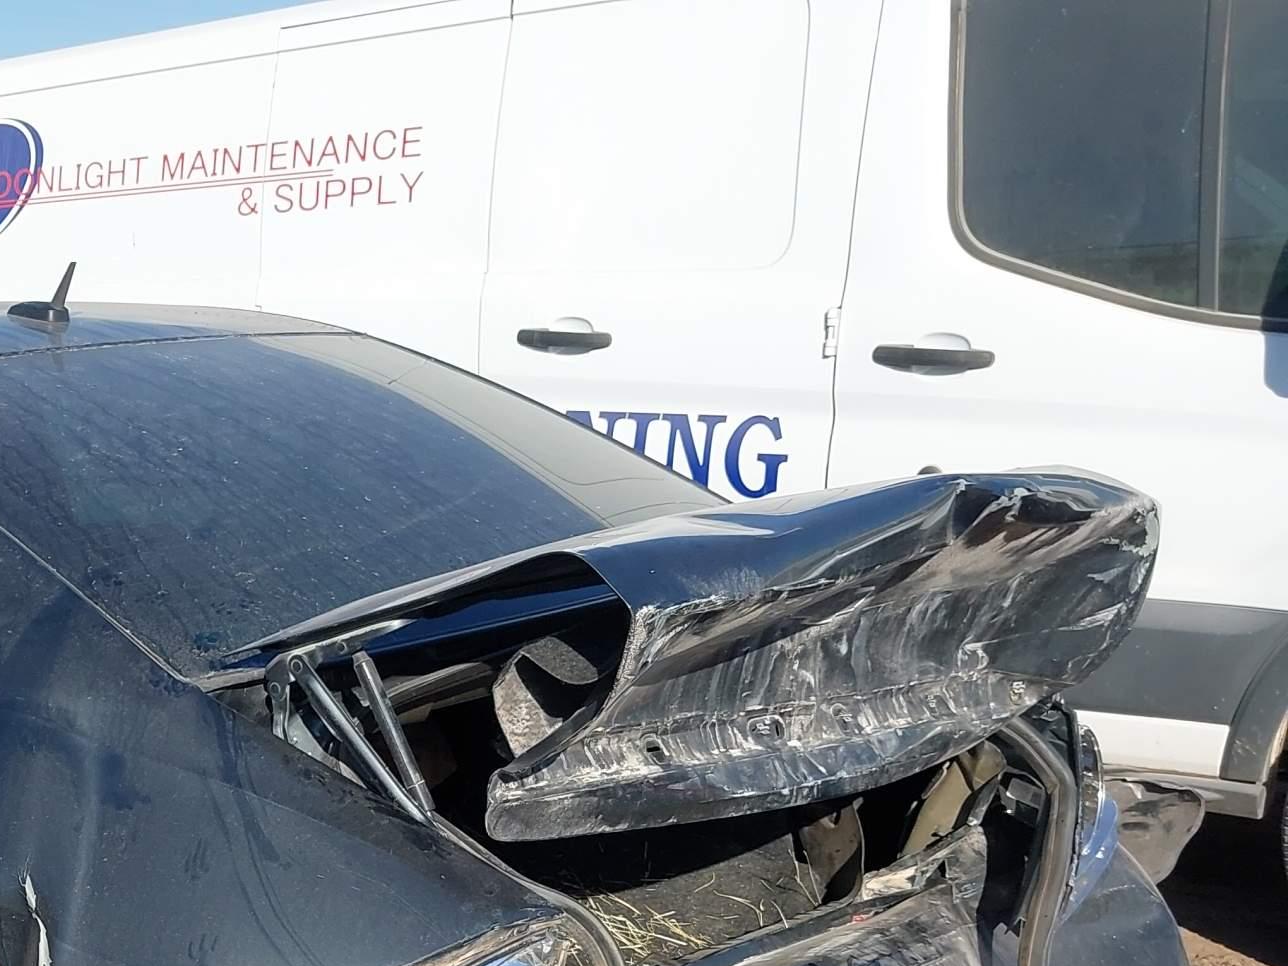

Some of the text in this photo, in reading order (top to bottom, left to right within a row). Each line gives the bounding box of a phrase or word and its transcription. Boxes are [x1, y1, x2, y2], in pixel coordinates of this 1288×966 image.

[160, 126, 424, 183] MAINTENANCE
[237, 171, 425, 216] & SUPPLY
